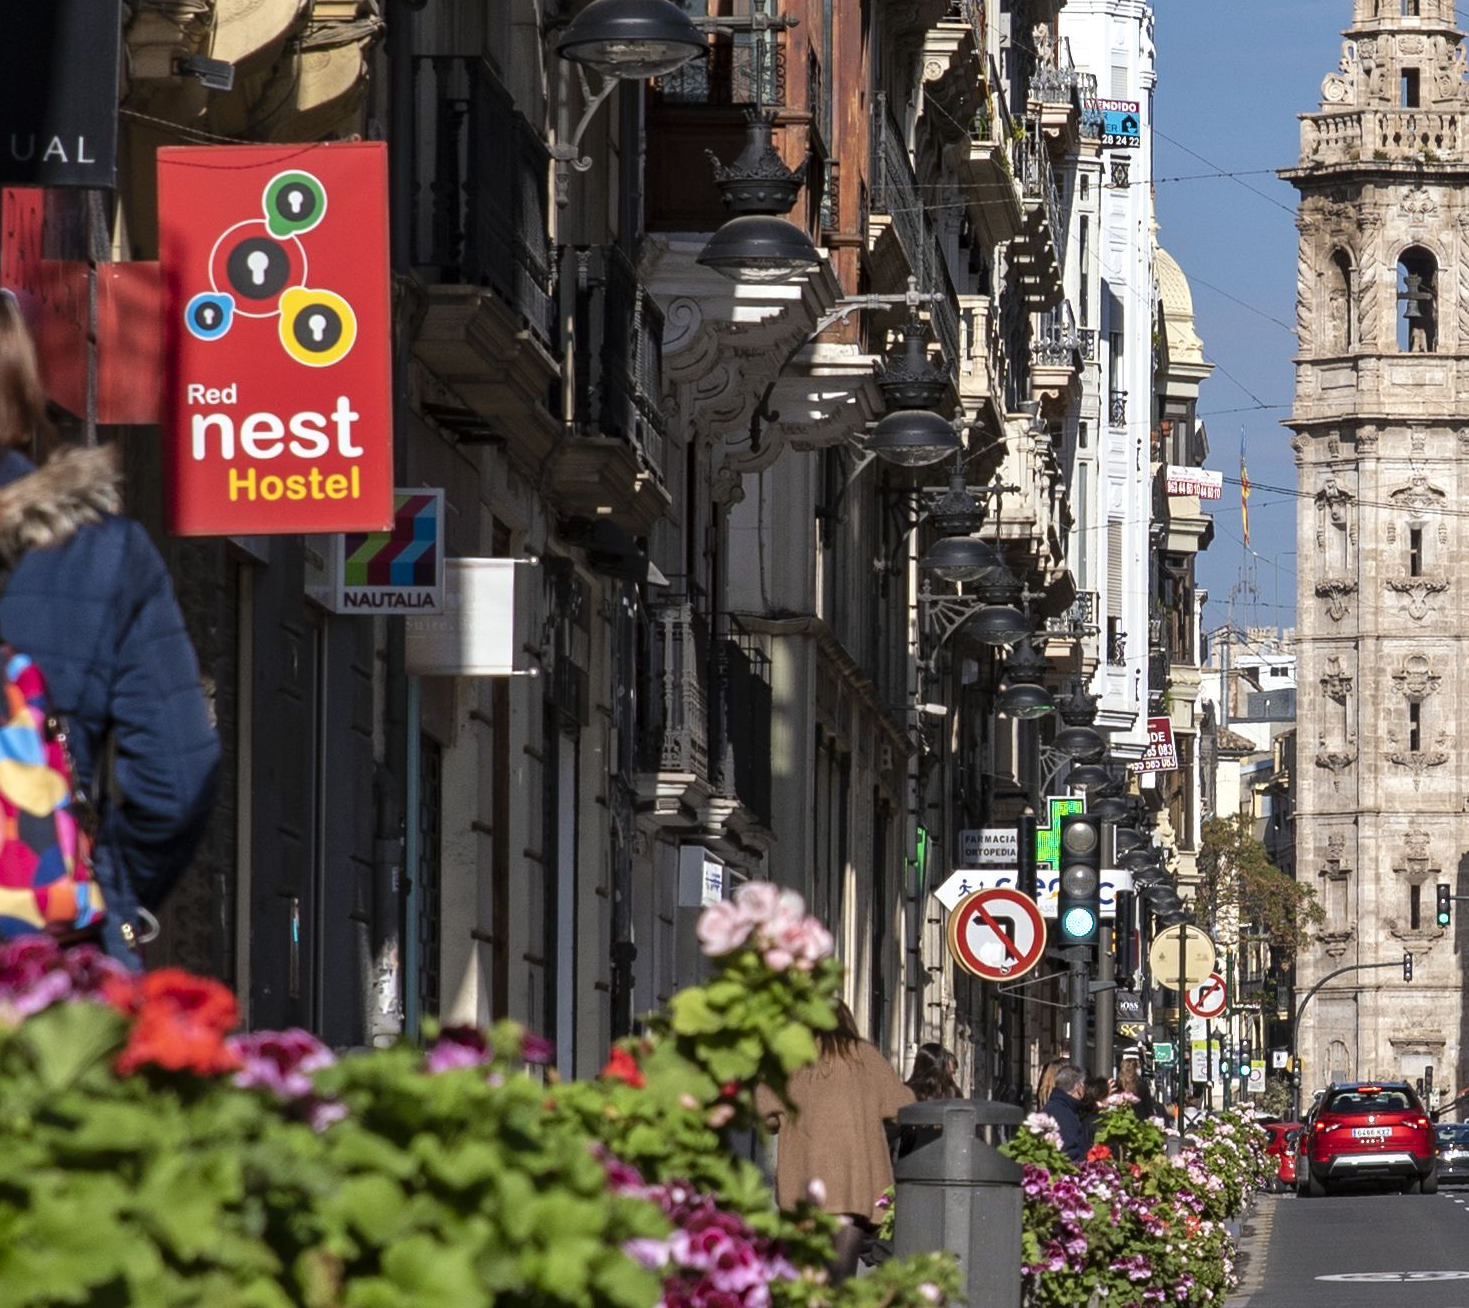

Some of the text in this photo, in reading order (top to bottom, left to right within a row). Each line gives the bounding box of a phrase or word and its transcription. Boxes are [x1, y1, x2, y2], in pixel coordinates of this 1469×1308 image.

[187, 383, 238, 405] Red
[191, 395, 364, 461] nest
[228, 465, 361, 502] Hostel
[343, 591, 436, 609] NAUTALIA
[965, 834, 1017, 844] FARMACIA
[965, 847, 1017, 857] ORTOPEDIA
